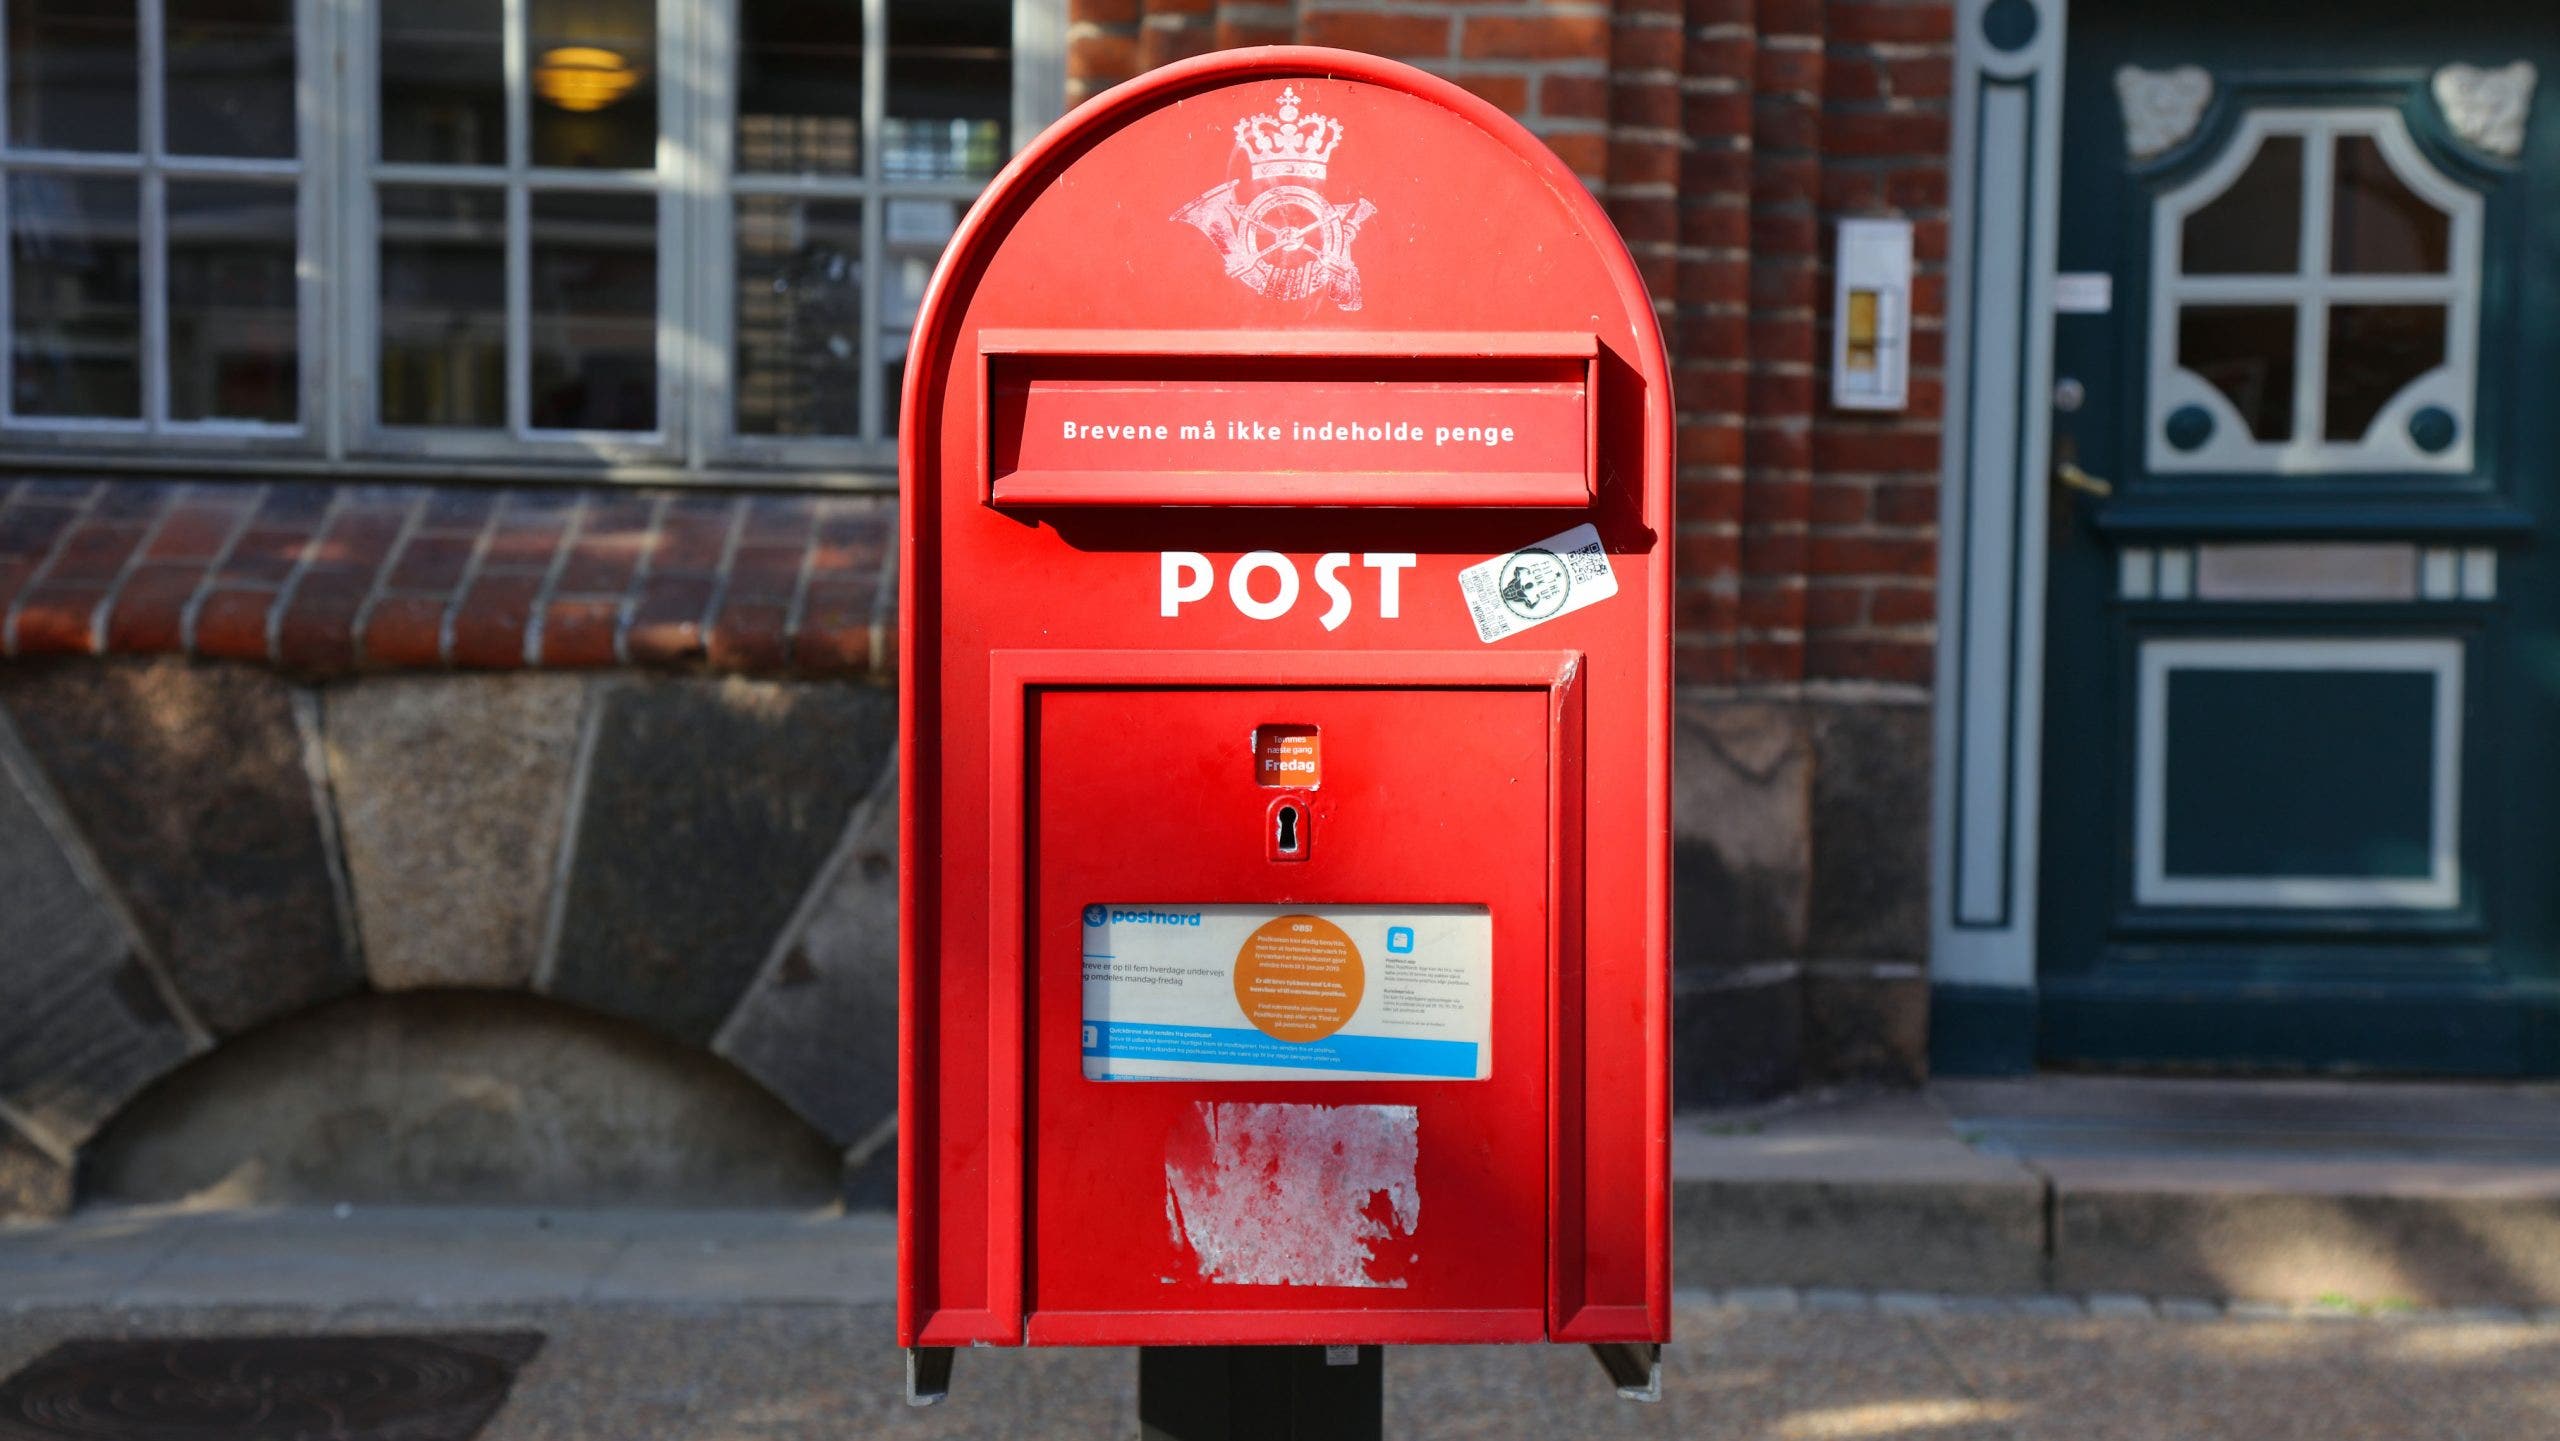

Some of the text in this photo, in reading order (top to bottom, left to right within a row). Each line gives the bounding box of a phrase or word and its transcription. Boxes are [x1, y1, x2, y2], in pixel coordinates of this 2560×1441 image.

[1063, 420, 1515, 446] Brevene må ikke indeholde penge
[1540, 560, 1560, 597] FIT THE
[1160, 549, 1417, 632] POST
[1292, 747, 1313, 755] gang
[1265, 759, 1315, 773] Fredag
[1112, 910, 1201, 927] postnord
[1292, 924, 1313, 932] OBS!
[1113, 964, 1123, 973] op
[1124, 963, 1132, 971] til
[1133, 963, 1148, 972] fem
[1149, 964, 1186, 976] hverdage
[1187, 967, 1225, 978] undervejs
[1091, 973, 1123, 982] omdeles
[1125, 975, 1183, 987] mandag-fredag
